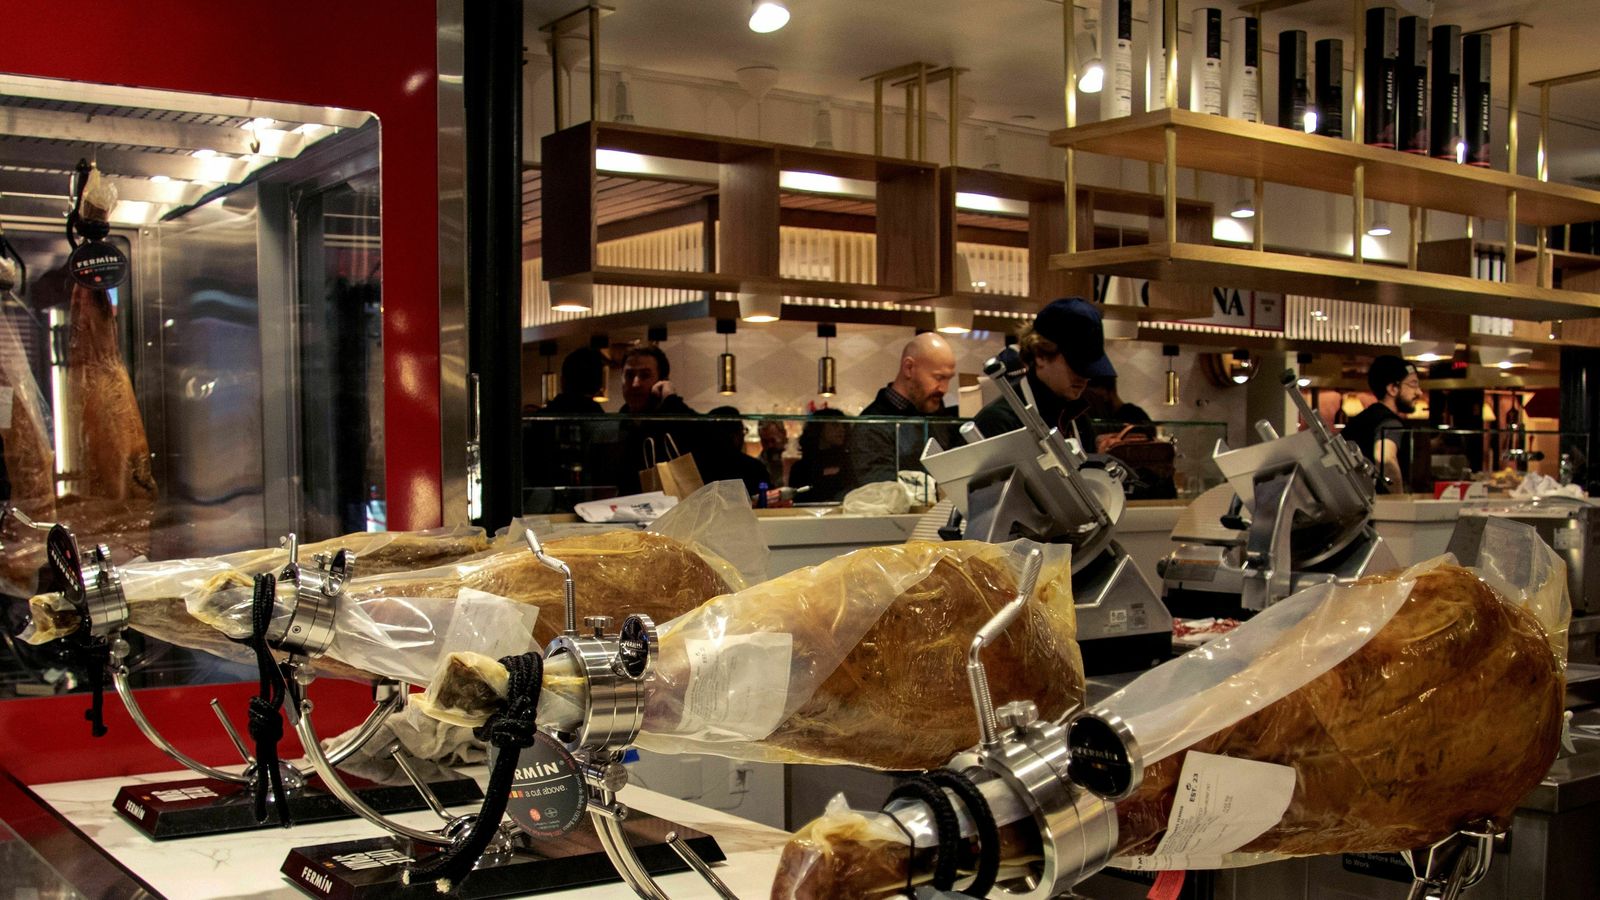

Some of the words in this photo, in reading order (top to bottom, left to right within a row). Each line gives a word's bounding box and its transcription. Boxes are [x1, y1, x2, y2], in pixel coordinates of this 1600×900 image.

[514, 761, 560, 780] RMÍN
[525, 790, 531, 798] a
[530, 788, 542, 797] cut
[542, 784, 568, 796] above.
[300, 865, 333, 895] FERMÍN
